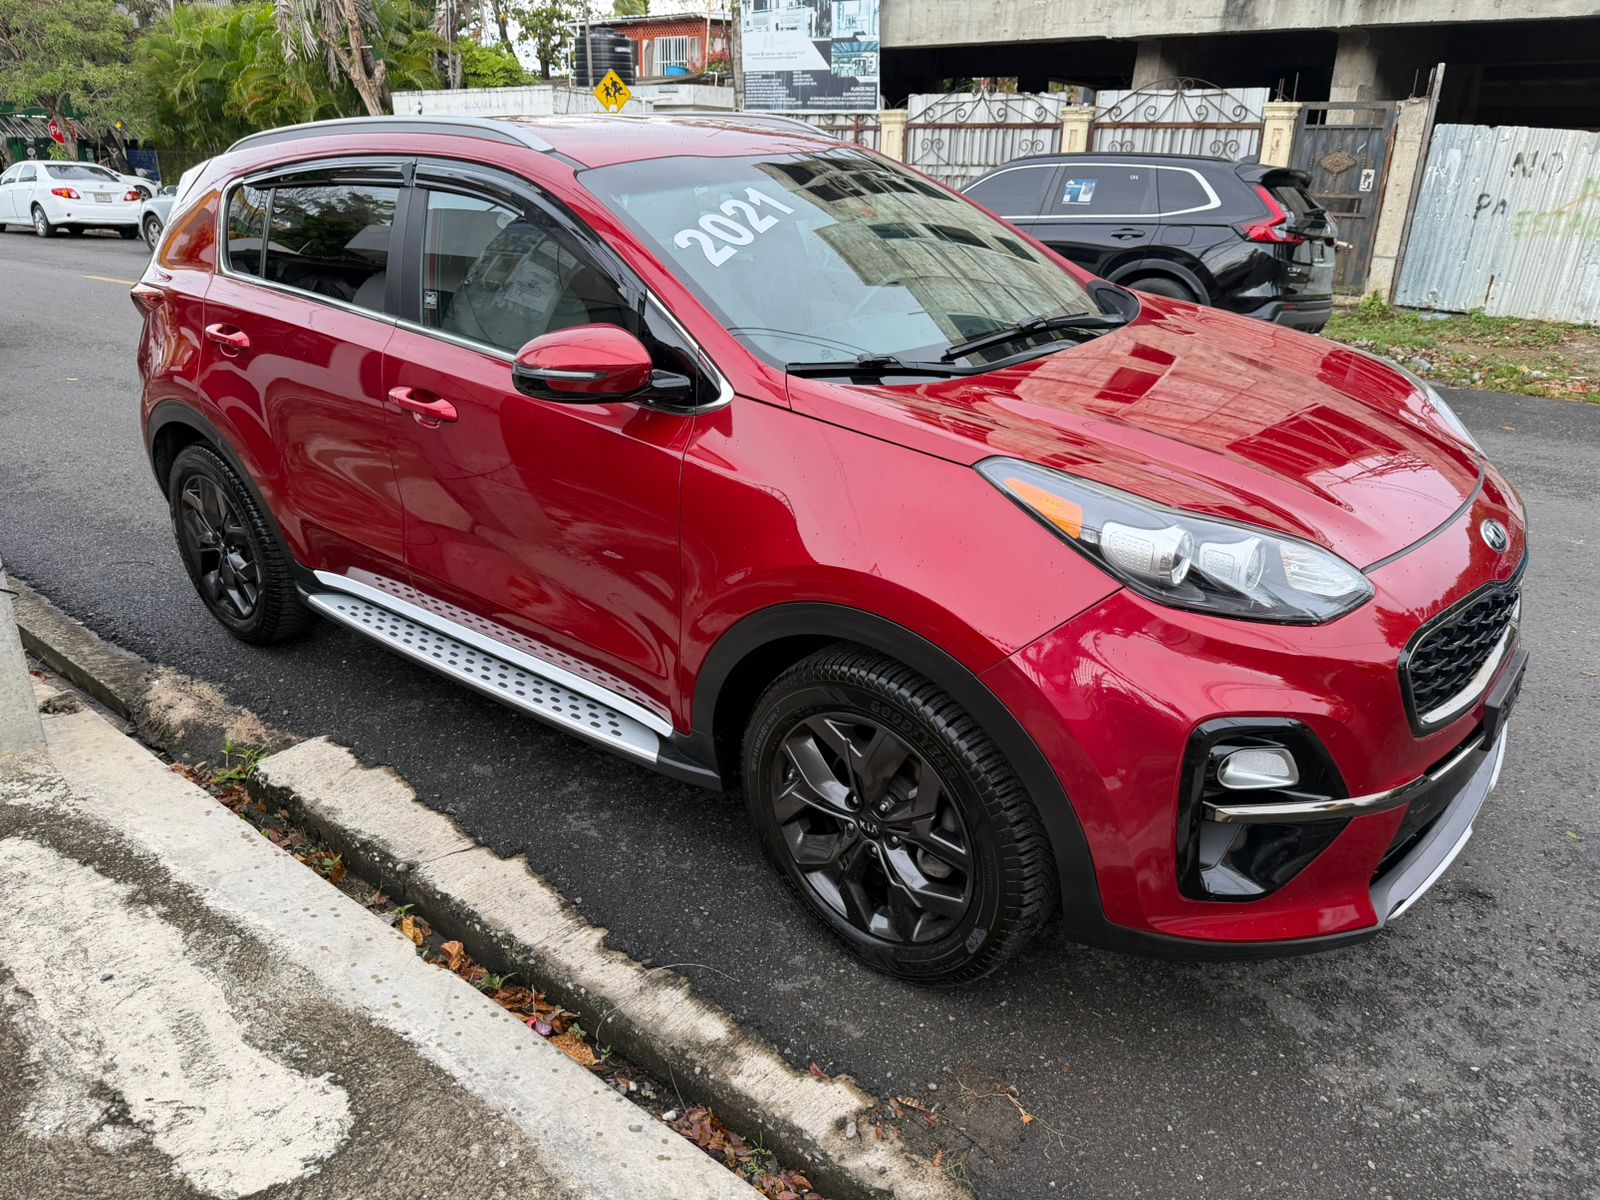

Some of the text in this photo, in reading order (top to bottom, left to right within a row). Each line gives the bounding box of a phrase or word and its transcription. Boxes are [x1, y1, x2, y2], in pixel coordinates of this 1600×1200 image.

[1510, 150, 1564, 178] NO
[673, 186, 794, 267] 2021
[859, 819, 880, 834] KIA
